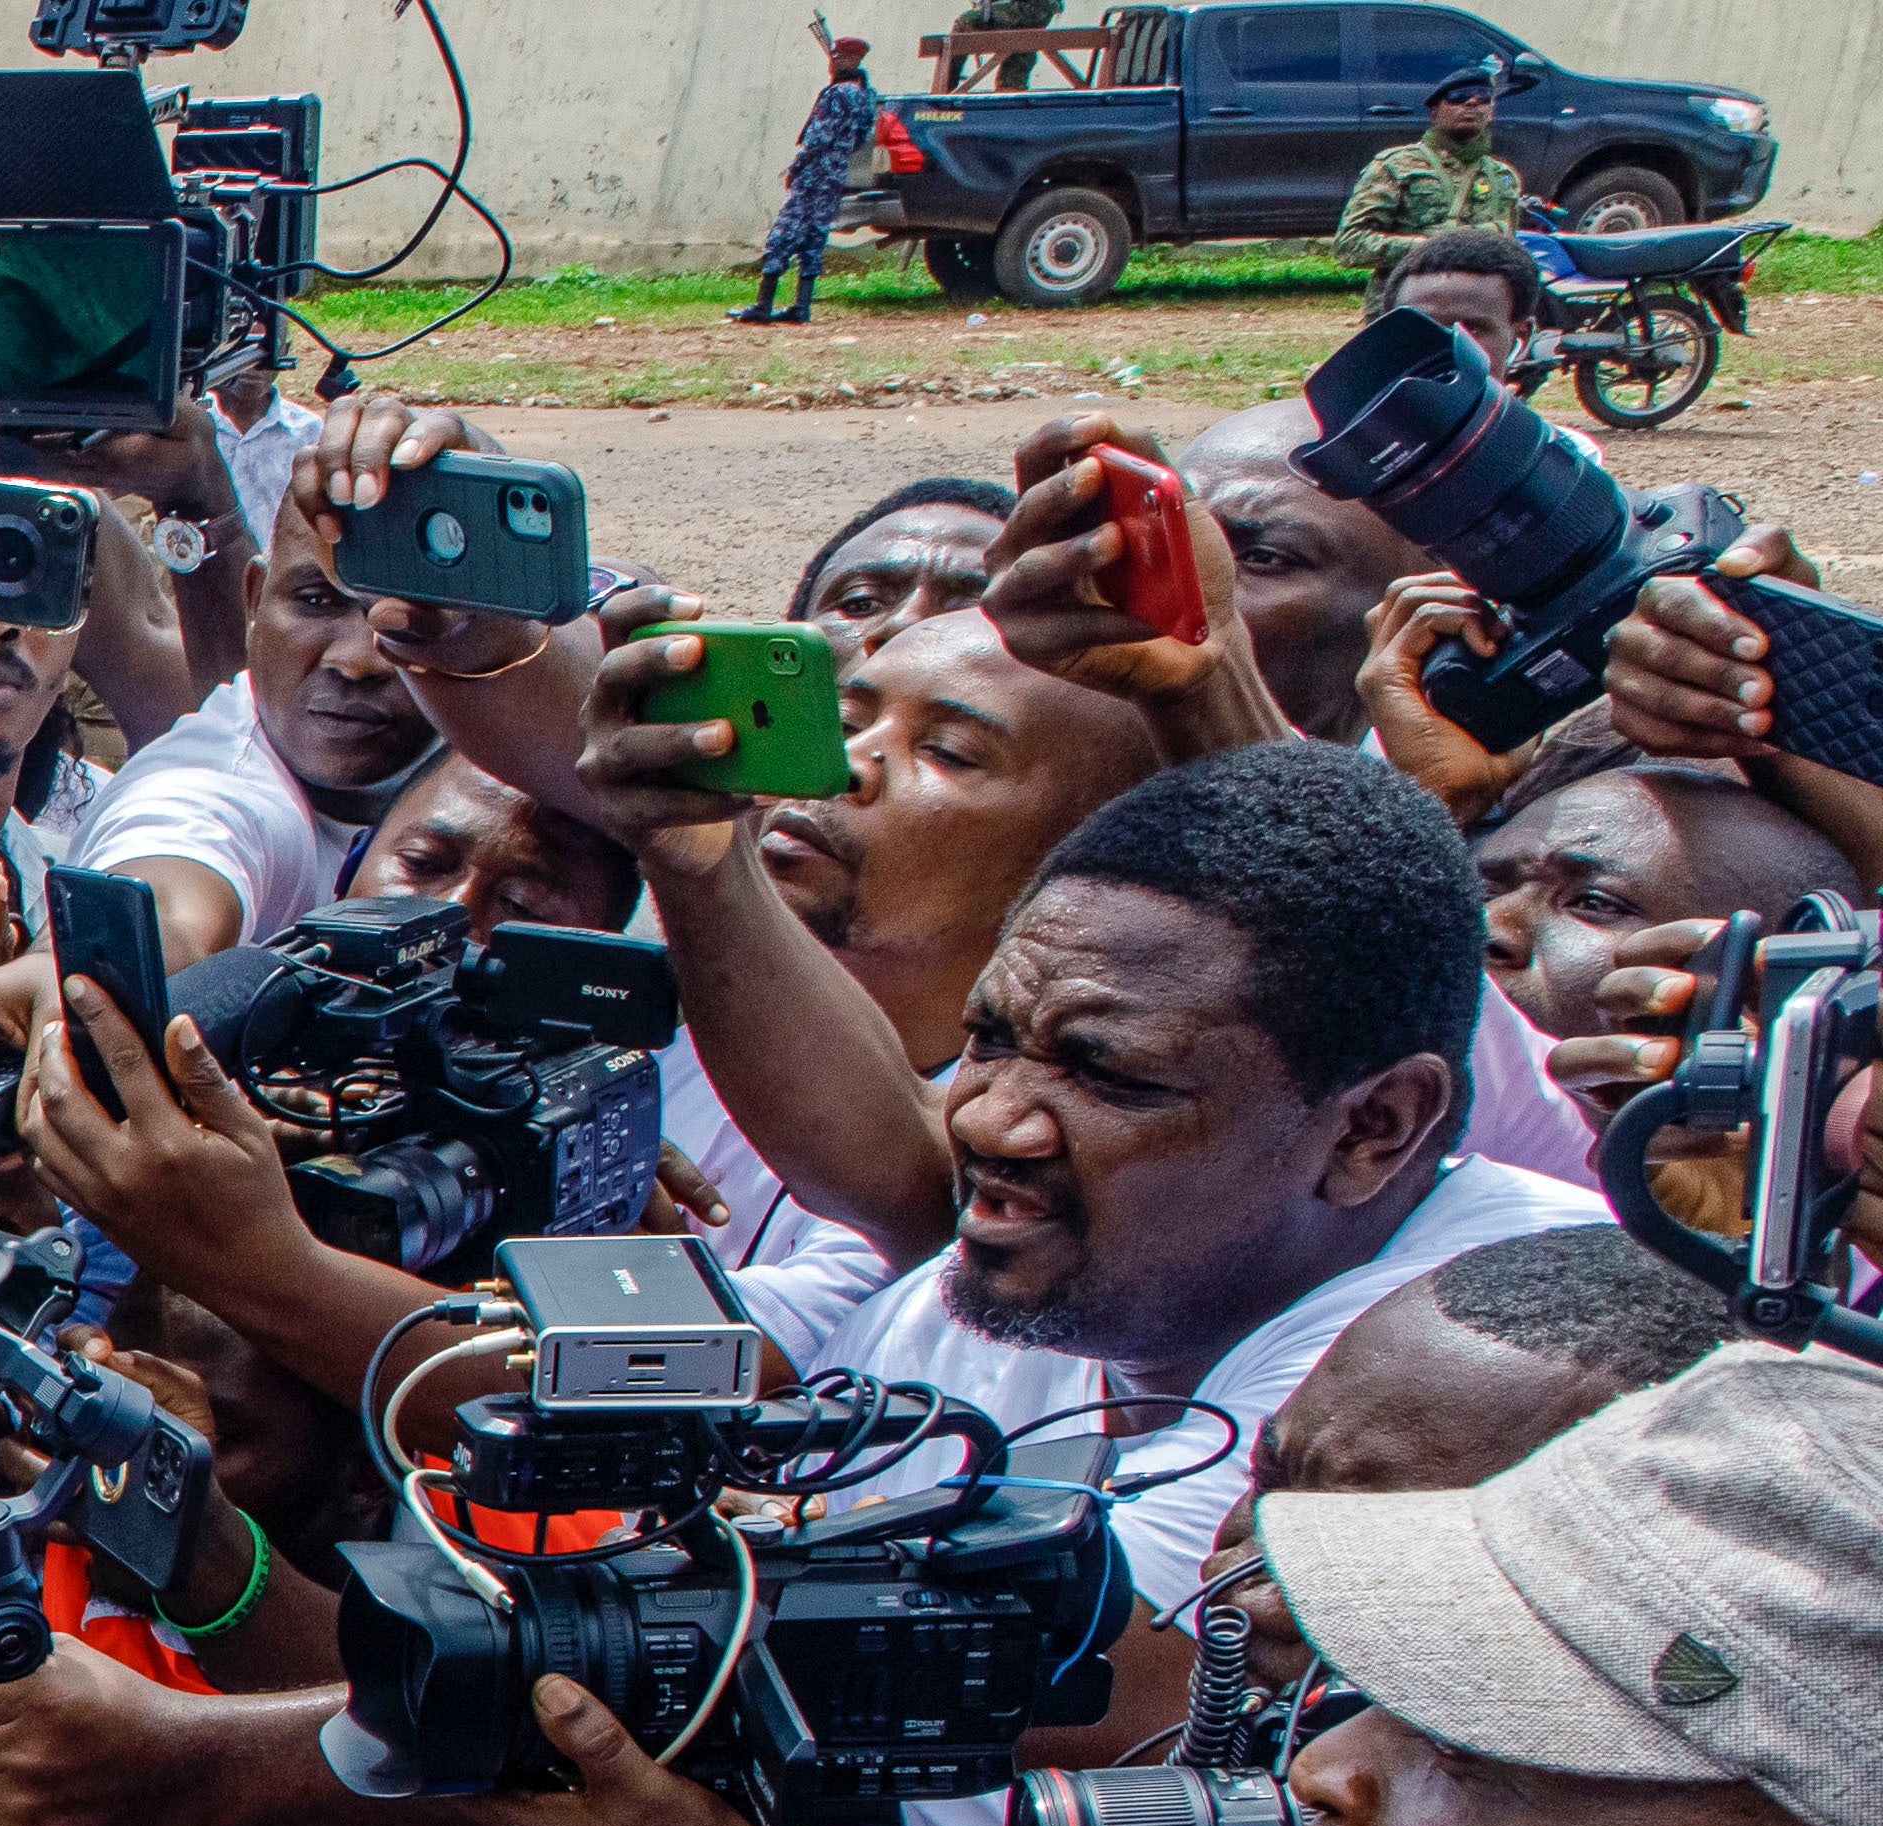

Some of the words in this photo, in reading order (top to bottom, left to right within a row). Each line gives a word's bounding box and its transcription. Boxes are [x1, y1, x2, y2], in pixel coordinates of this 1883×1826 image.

[581, 984, 630, 1001] SONY
[604, 1049, 647, 1073] SONY
[452, 1441, 473, 1473] JVC
